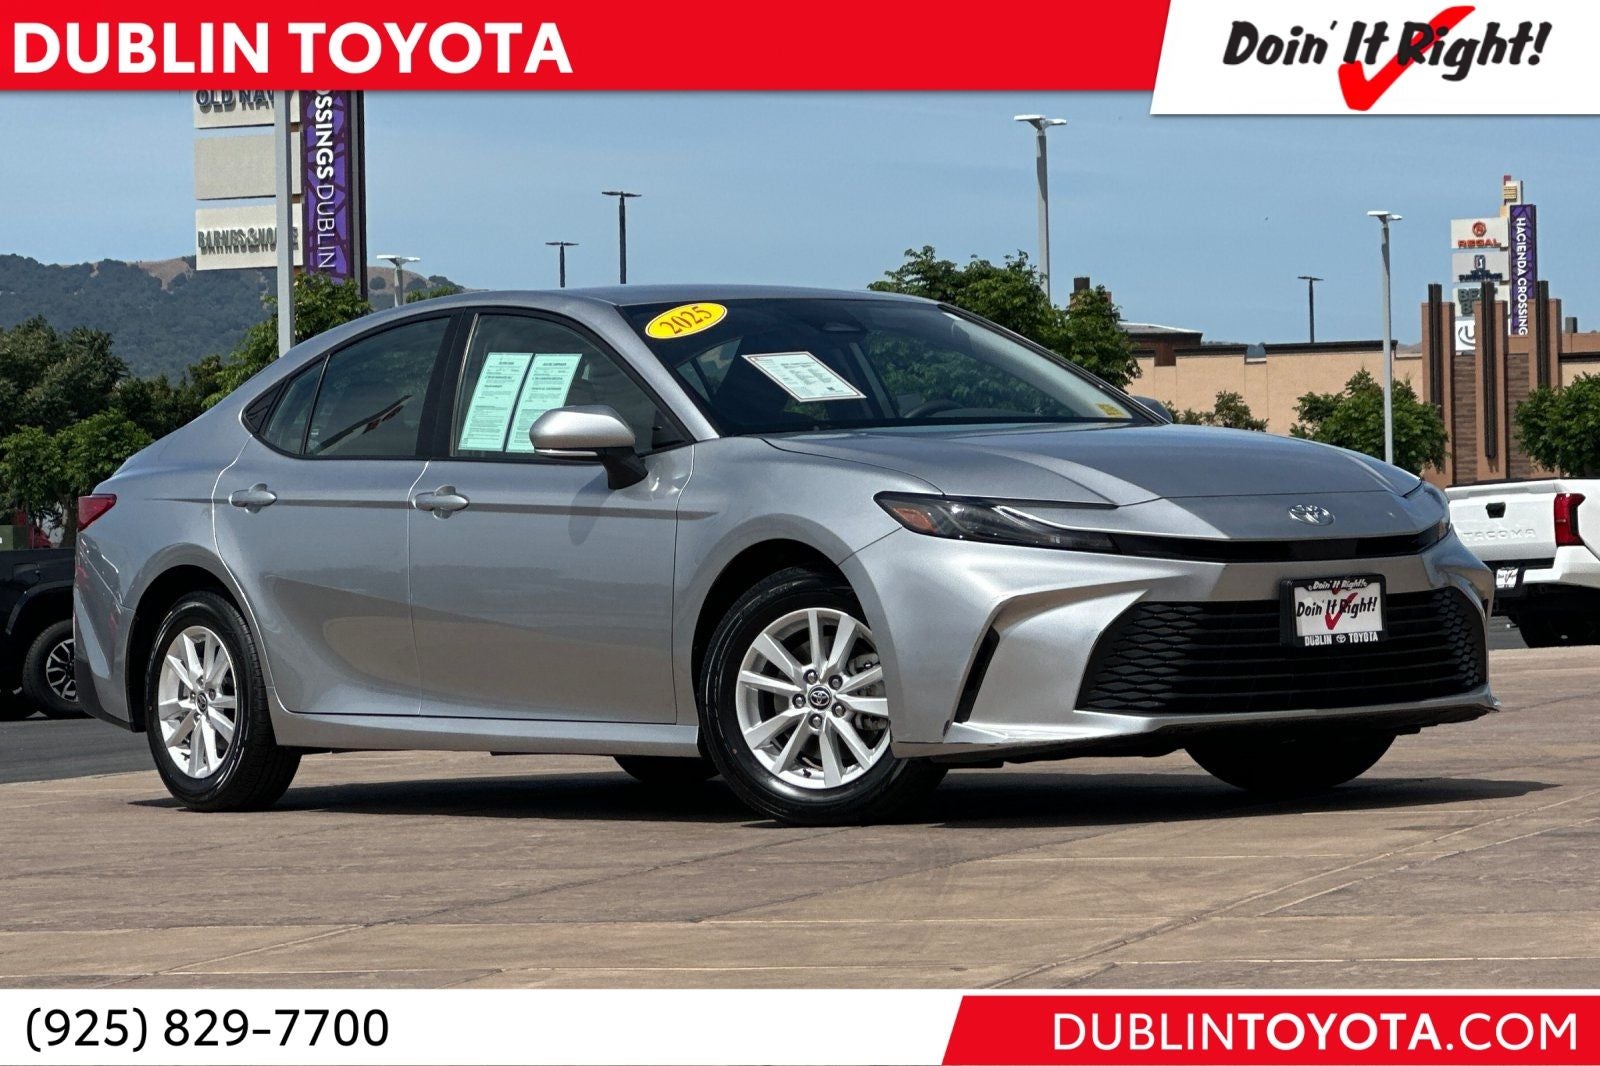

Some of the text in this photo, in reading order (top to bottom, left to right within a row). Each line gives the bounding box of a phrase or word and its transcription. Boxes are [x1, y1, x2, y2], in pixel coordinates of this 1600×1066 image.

[196, 90, 234, 105] OLD
[316, 184, 336, 268] DUBLIN
[1457, 238, 1500, 248] REGAL
[1516, 217, 1529, 335] HACIENDA CROSSING
[659, 305, 712, 335] 2025
[1463, 528, 1536, 542] TACOMA
[1296, 596, 1378, 619] Doin' It Right!
[1304, 631, 1379, 647] DUBLIN TOYOTA
